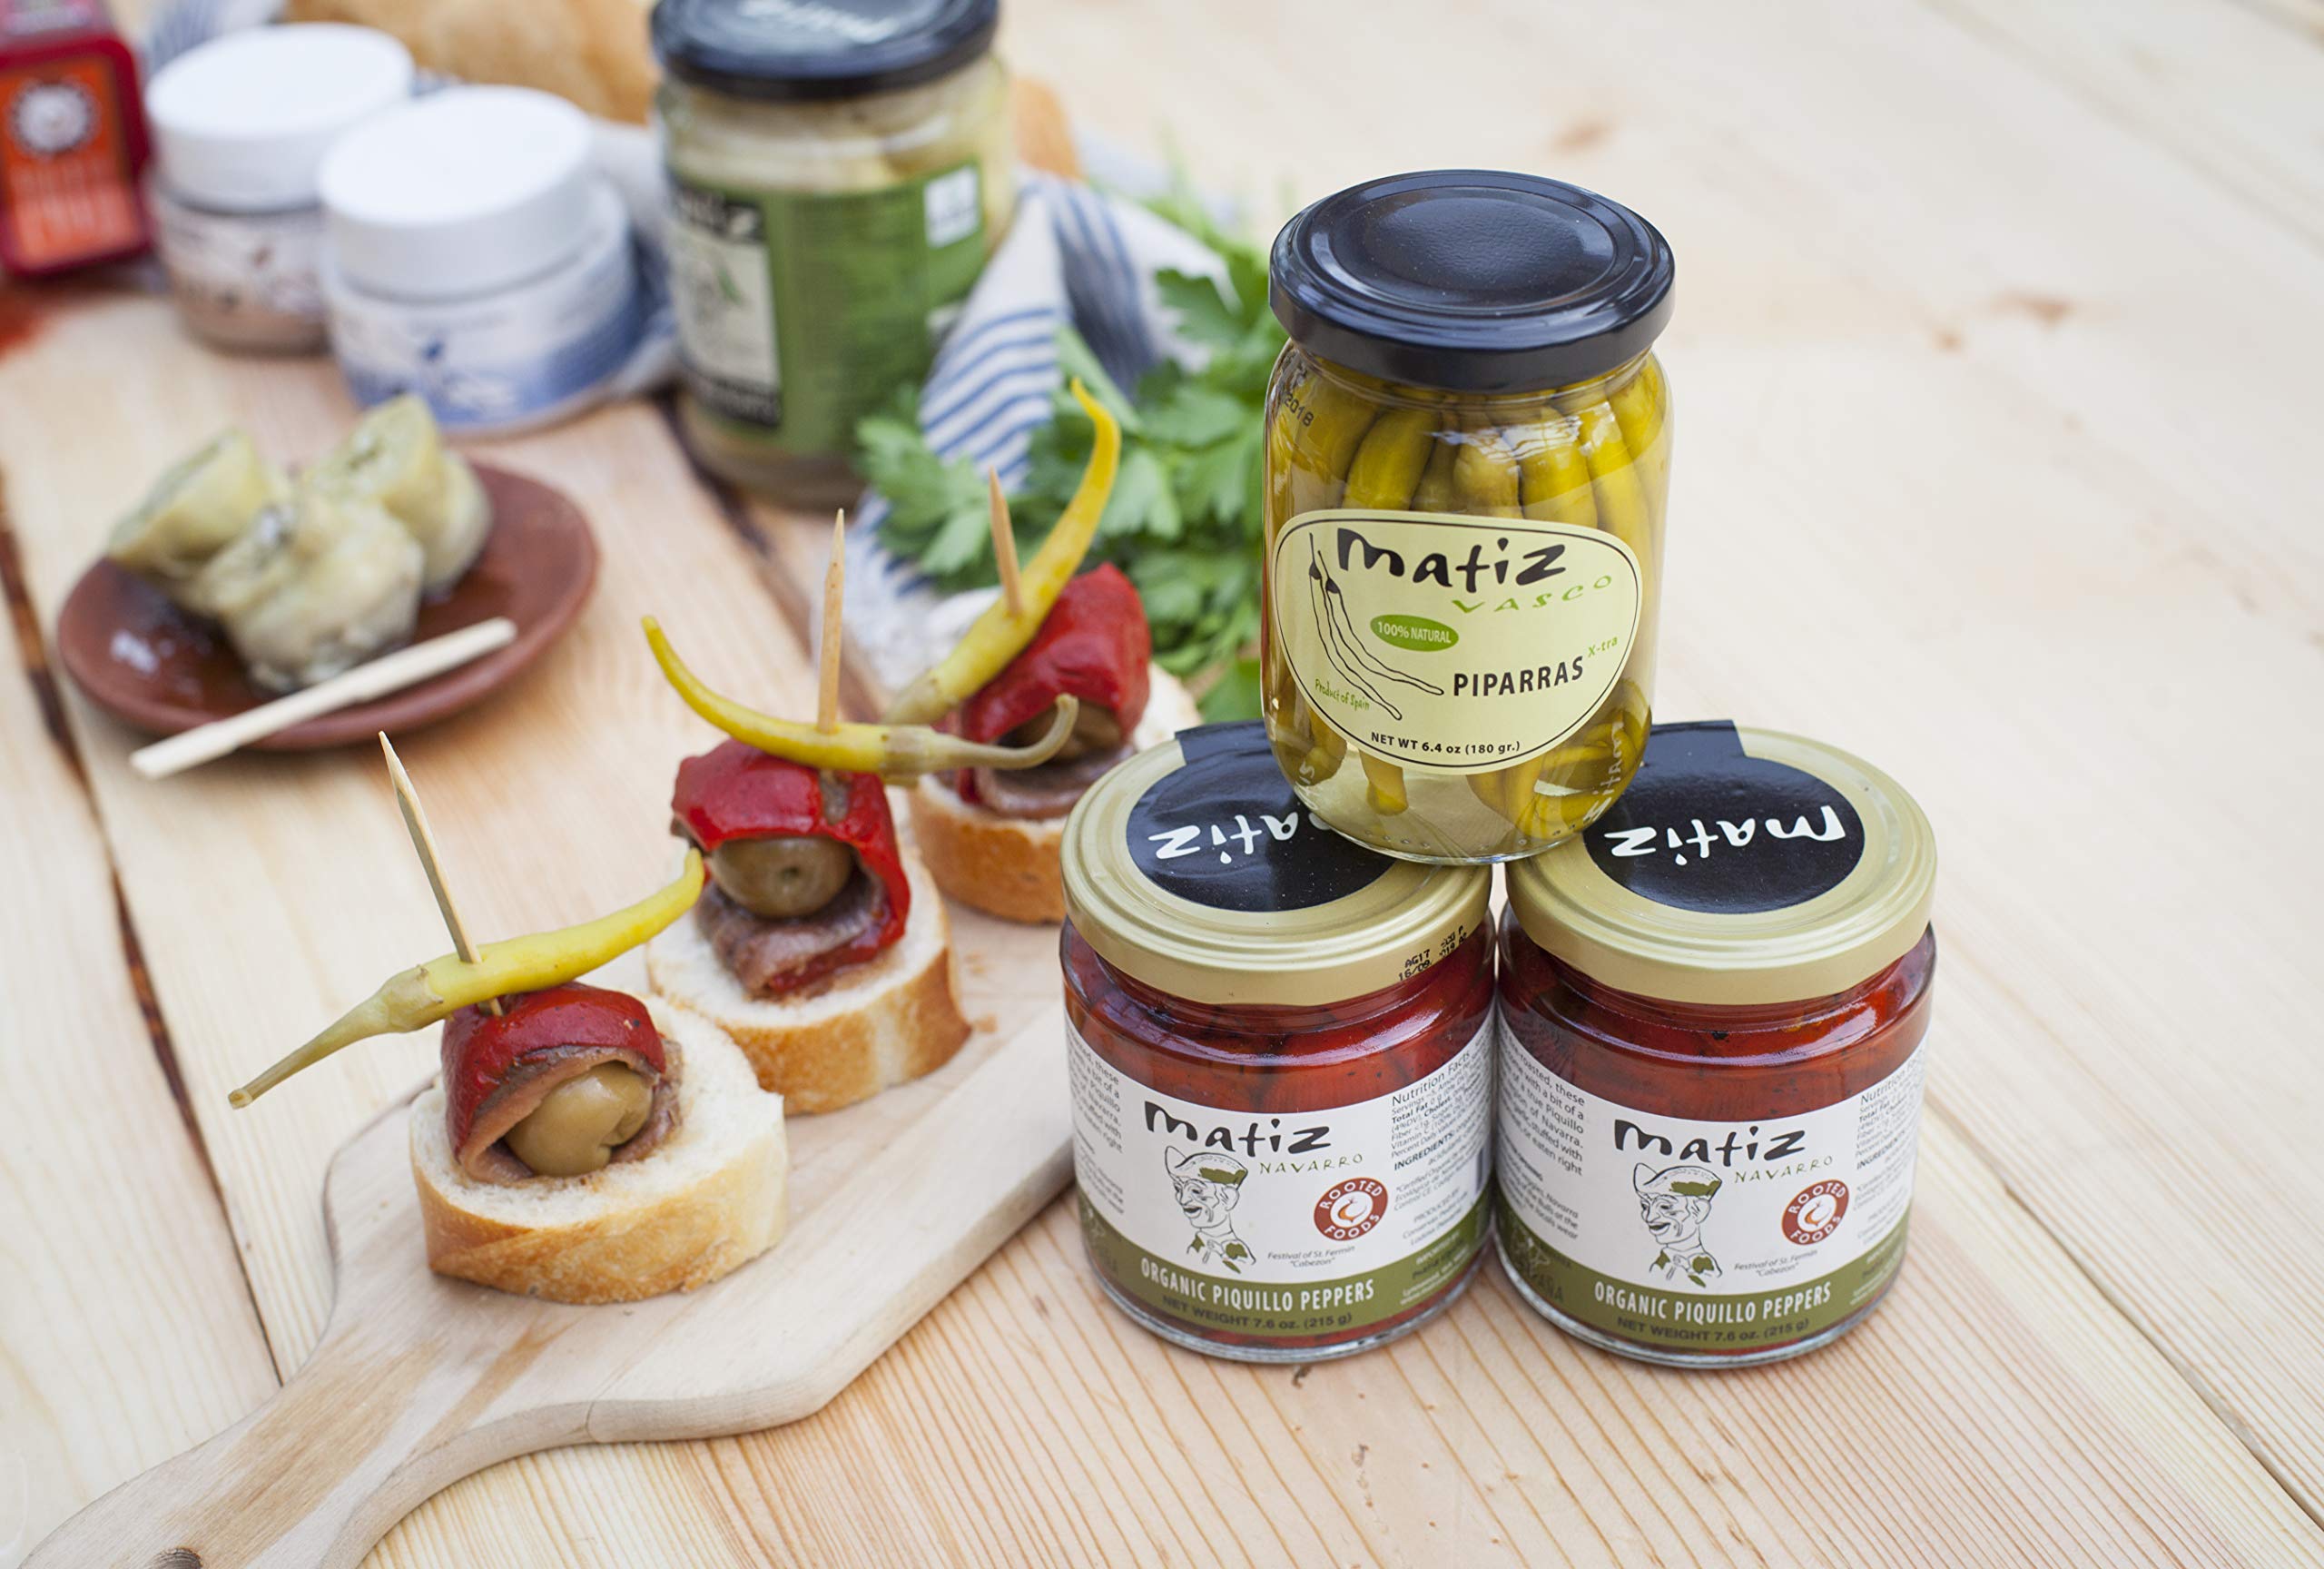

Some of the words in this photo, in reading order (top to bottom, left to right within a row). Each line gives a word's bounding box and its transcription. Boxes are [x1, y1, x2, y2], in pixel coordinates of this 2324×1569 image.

[1452, 575, 1612, 614] VASCO
[1377, 621, 1409, 638] 100%
[1411, 627, 1452, 644] NATURAL
[1453, 656, 1584, 696] PIPARRAS
[1351, 694, 1370, 711] Spain
[1372, 731, 1394, 746] NET
[1398, 737, 1419, 750] WT
[1422, 741, 1442, 753] 6.4
[1446, 745, 1462, 754] oz
[1465, 744, 1494, 755] (180
[1499, 741, 1521, 755] gr.)
[1392, 1072, 1445, 1107] Nutrition
[1448, 1051, 1471, 1076] Facts
[1550, 1091, 1562, 1108] bit
[1564, 1102, 1576, 1115] of
[1577, 1112, 1584, 1120] a
[1555, 1082, 1586, 1107] these
[1392, 1110, 1413, 1124] Total
[1546, 1103, 1584, 1134] Piquillo
[1541, 1115, 1584, 1149] Navarra.
[1259, 1153, 1364, 1175] NAVARRO
[1558, 1155, 1583, 1177] right
[1561, 1142, 1583, 1162] with
[1734, 1155, 1834, 1184] NAVARRO
[1319, 1179, 1384, 1209] ROOTED
[1787, 1181, 1846, 1215] ROOTED
[1324, 1213, 1380, 1240] FOODS
[1789, 1216, 1842, 1244] FOODS
[1140, 1258, 1206, 1302] ORGANIC
[1213, 1284, 1294, 1313] PIQUILLO
[1300, 1278, 1375, 1311] PEPPERS
[1162, 1295, 1188, 1313] NET
[1193, 1308, 1250, 1327] WEIGHT
[1304, 1313, 1334, 1328] (215
[1594, 1281, 1667, 1319] ORGANIC
[1674, 1300, 1756, 1326] PIQUILLO
[1762, 1281, 1832, 1320] PEPPERS
[1617, 1317, 1644, 1333] NET
[1649, 1323, 1710, 1342] WEIGHT
[1763, 1322, 1793, 1338] (215
